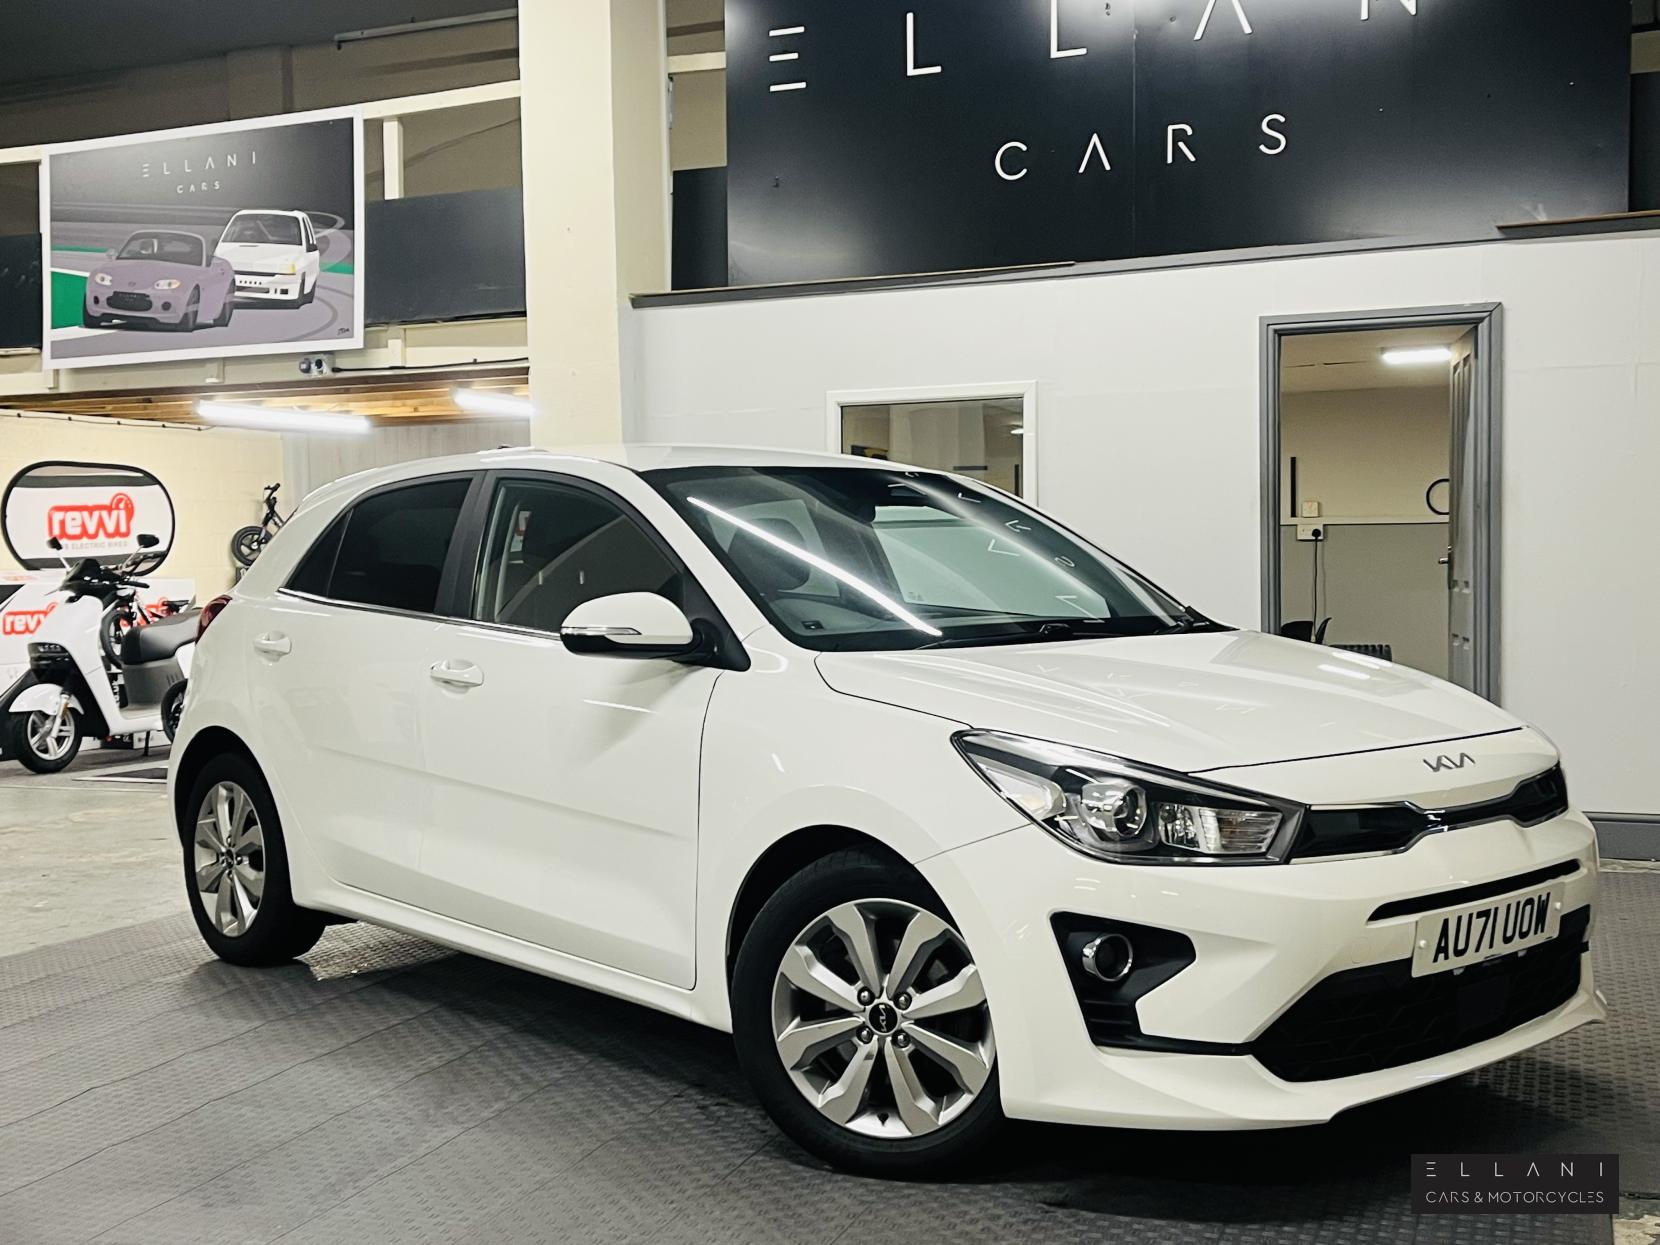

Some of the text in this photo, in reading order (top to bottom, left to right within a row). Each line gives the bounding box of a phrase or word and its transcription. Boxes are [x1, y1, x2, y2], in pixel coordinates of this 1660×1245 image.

[142, 151, 256, 177] ELLANI
[994, 113, 1288, 181] CARS
[176, 181, 220, 194] CARS
[50, 493, 131, 538] revvi
[1432, 892, 1551, 964] AU71 UOW
